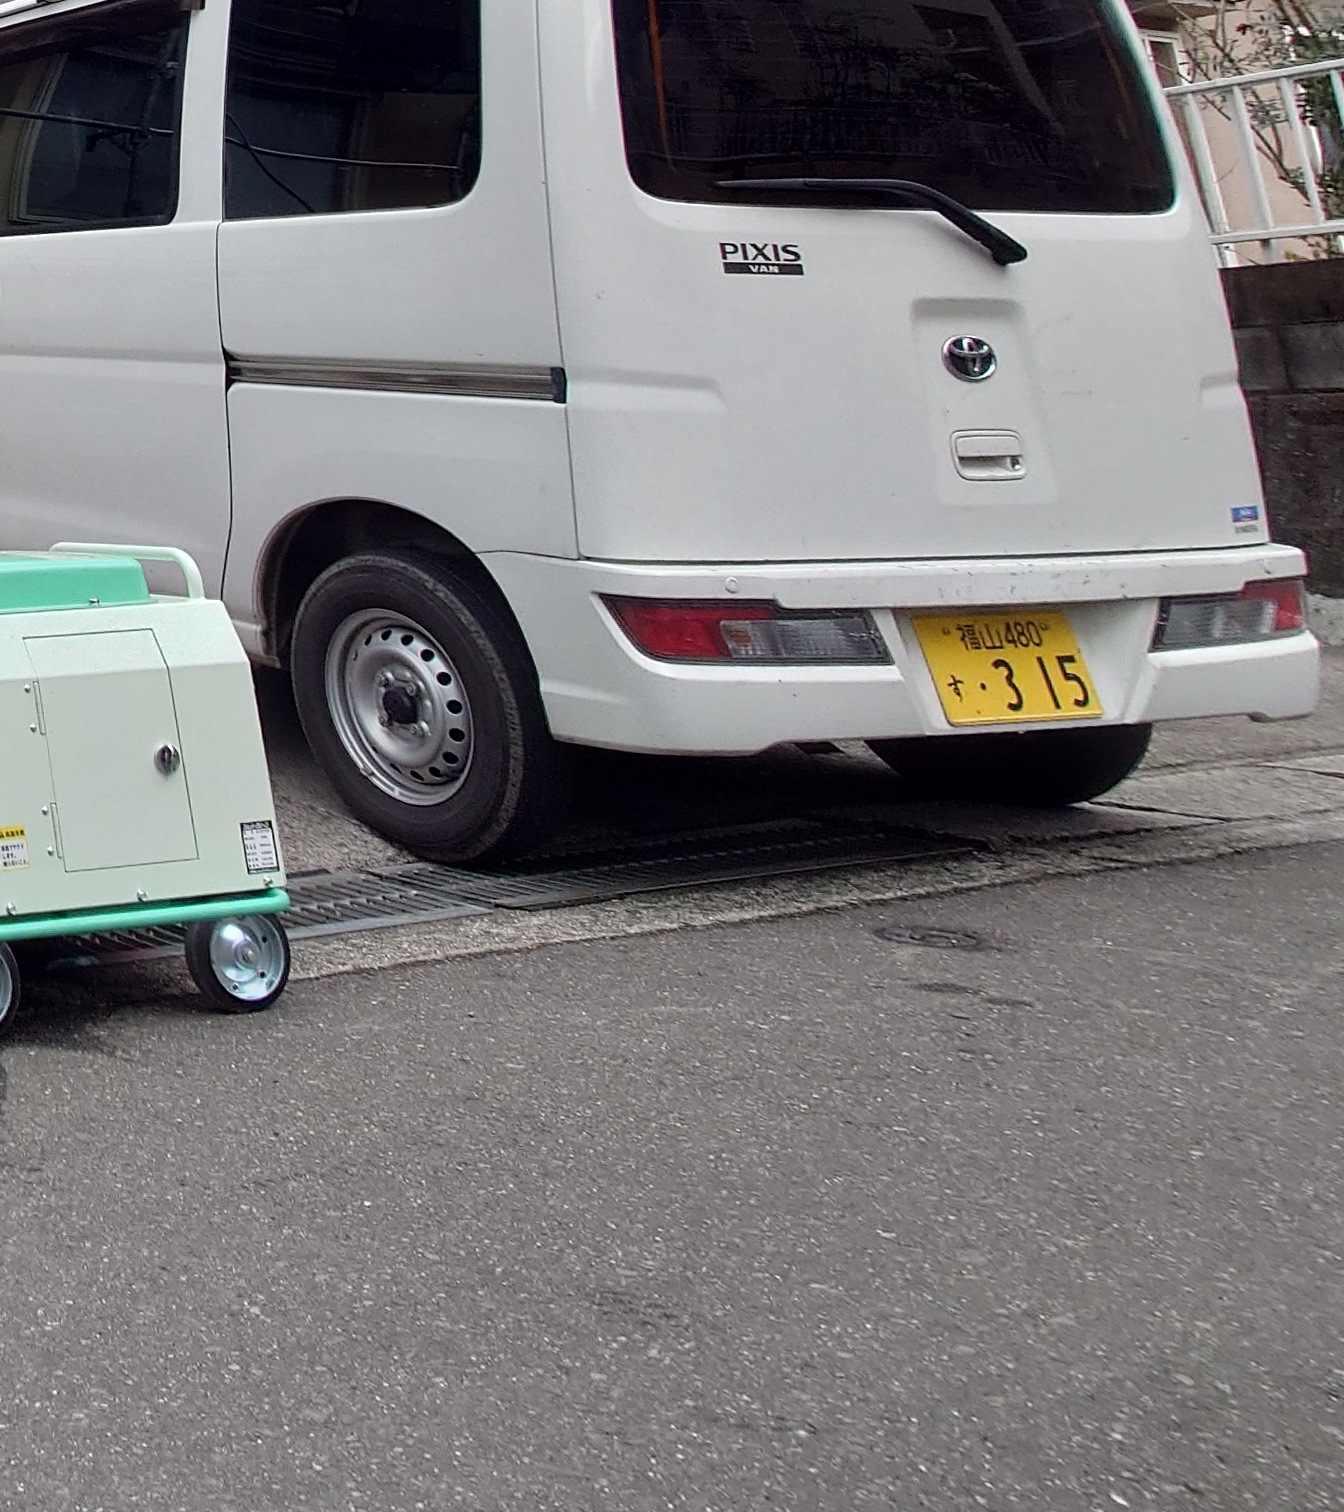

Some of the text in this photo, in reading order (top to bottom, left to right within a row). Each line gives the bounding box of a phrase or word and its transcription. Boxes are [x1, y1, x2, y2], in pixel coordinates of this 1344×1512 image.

[719, 242, 802, 262] PIXIS
[748, 264, 780, 274] VAN
[946, 674, 965, 703] す
